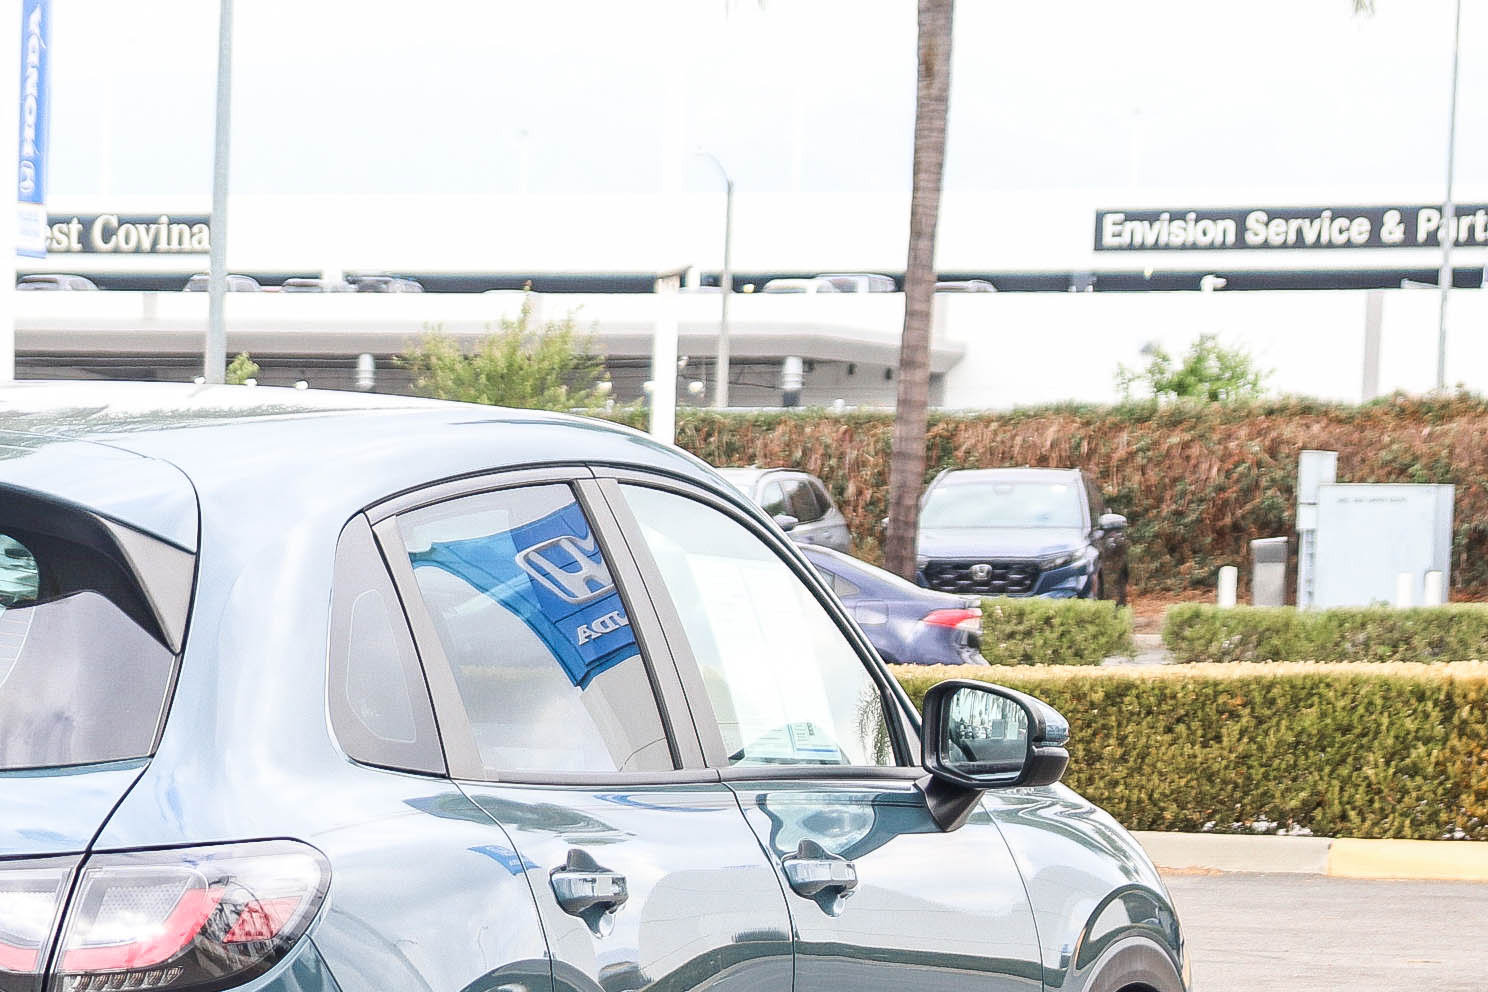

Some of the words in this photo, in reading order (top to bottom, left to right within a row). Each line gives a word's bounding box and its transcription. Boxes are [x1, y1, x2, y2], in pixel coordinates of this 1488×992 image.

[46, 216, 83, 250] est
[91, 213, 211, 251] Covina
[1102, 211, 1237, 247] Envision
[1244, 209, 1372, 246] Service
[1379, 209, 1406, 244] &
[1416, 208, 1488, 242] Part
